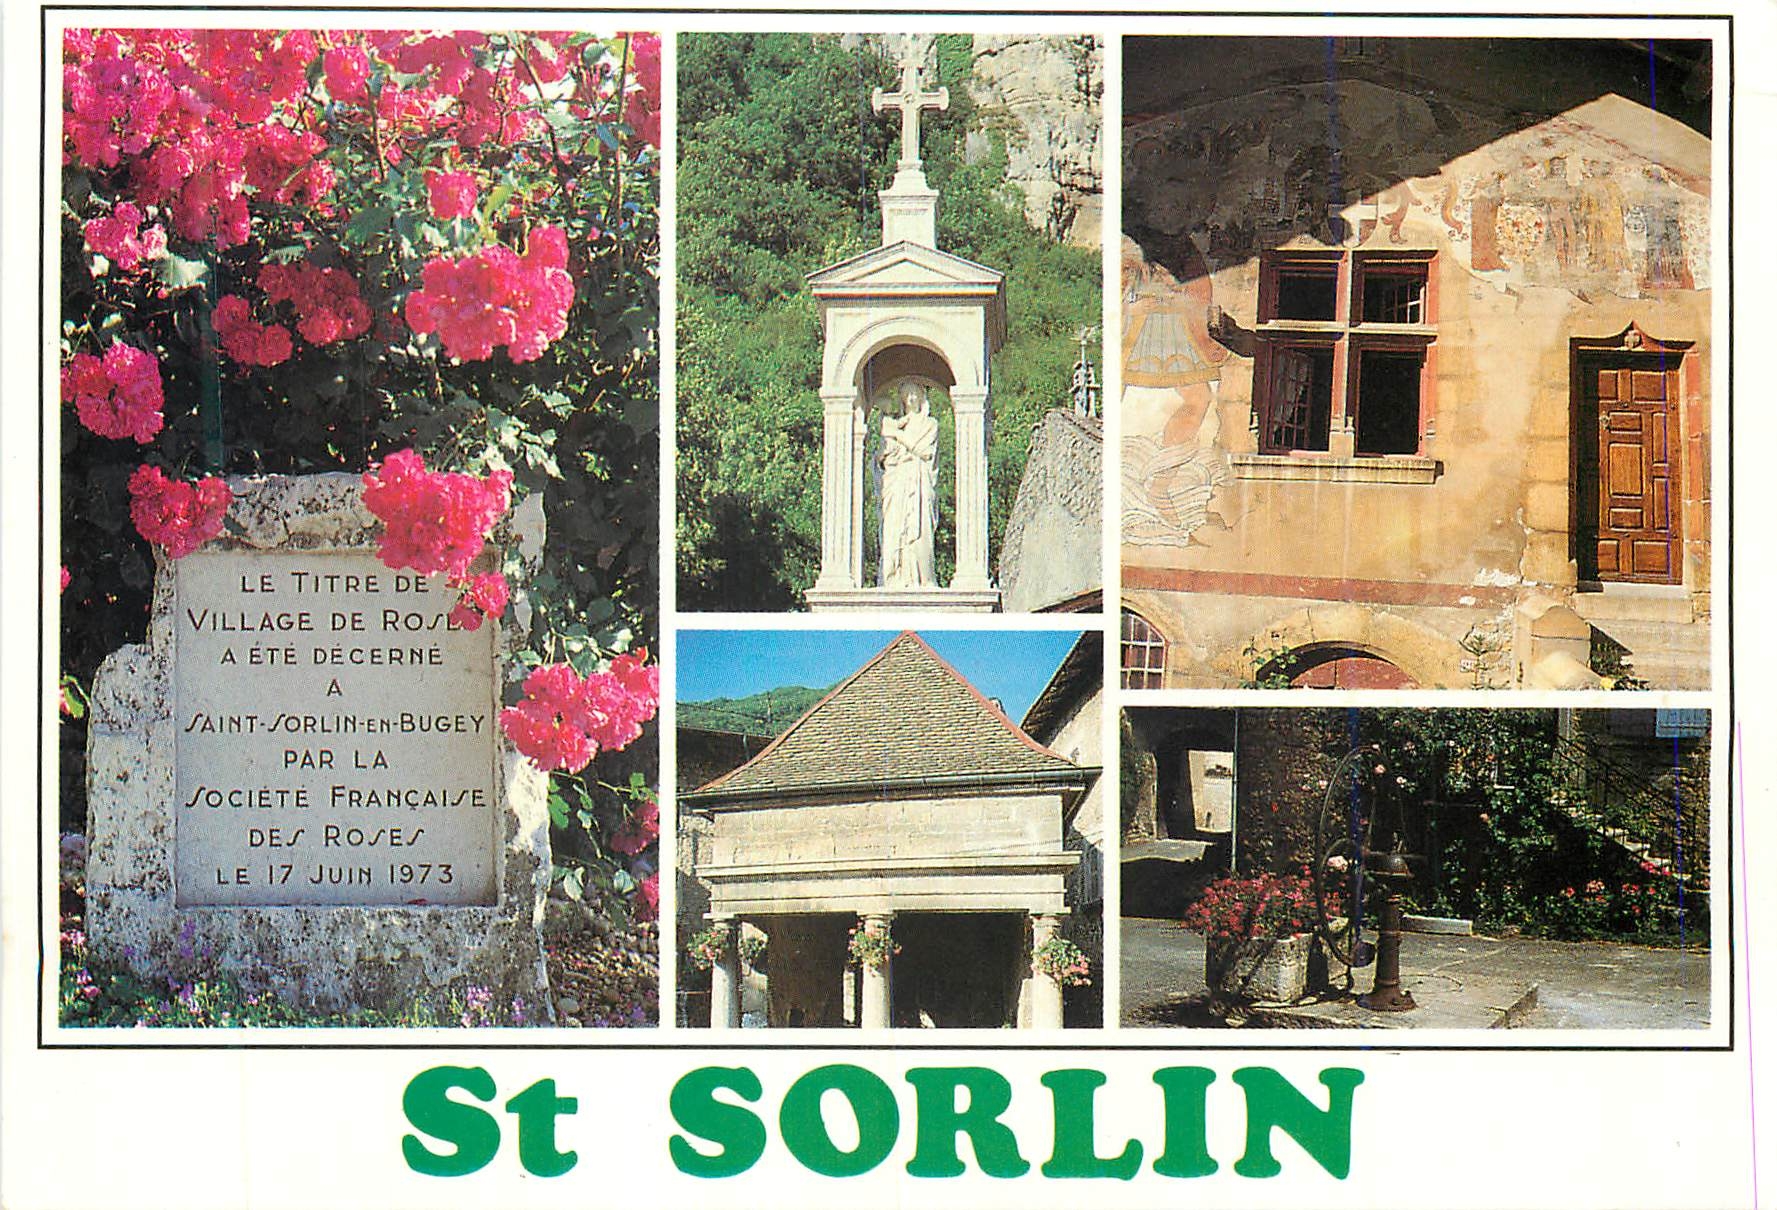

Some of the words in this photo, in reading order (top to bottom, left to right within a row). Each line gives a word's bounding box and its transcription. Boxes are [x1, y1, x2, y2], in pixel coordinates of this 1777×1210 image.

[241, 574, 274, 593] LE
[290, 571, 379, 593] TITRE
[395, 574, 429, 593] DE
[187, 608, 314, 632] VILLAGE
[331, 612, 366, 632] DE
[383, 609, 478, 632] ROSE
[221, 649, 236, 665] A
[249, 641, 297, 665] ÉTÉ
[314, 641, 443, 666] DÉCERNÉ
[326, 679, 343, 697] A
[184, 713, 485, 734] SAINT-SORLIN-EN-BUGEY
[284, 750, 333, 769] PAR
[354, 750, 388, 769] LA
[185, 785, 309, 808] SOCIÉTÉ
[331, 785, 486, 811] FRANÇAISE
[249, 828, 305, 847] DES
[325, 825, 424, 847] ROSES
[217, 867, 249, 885] LE
[268, 865, 294, 884] 17
[309, 864, 372, 885] JUIN
[390, 864, 453, 884] 1973
